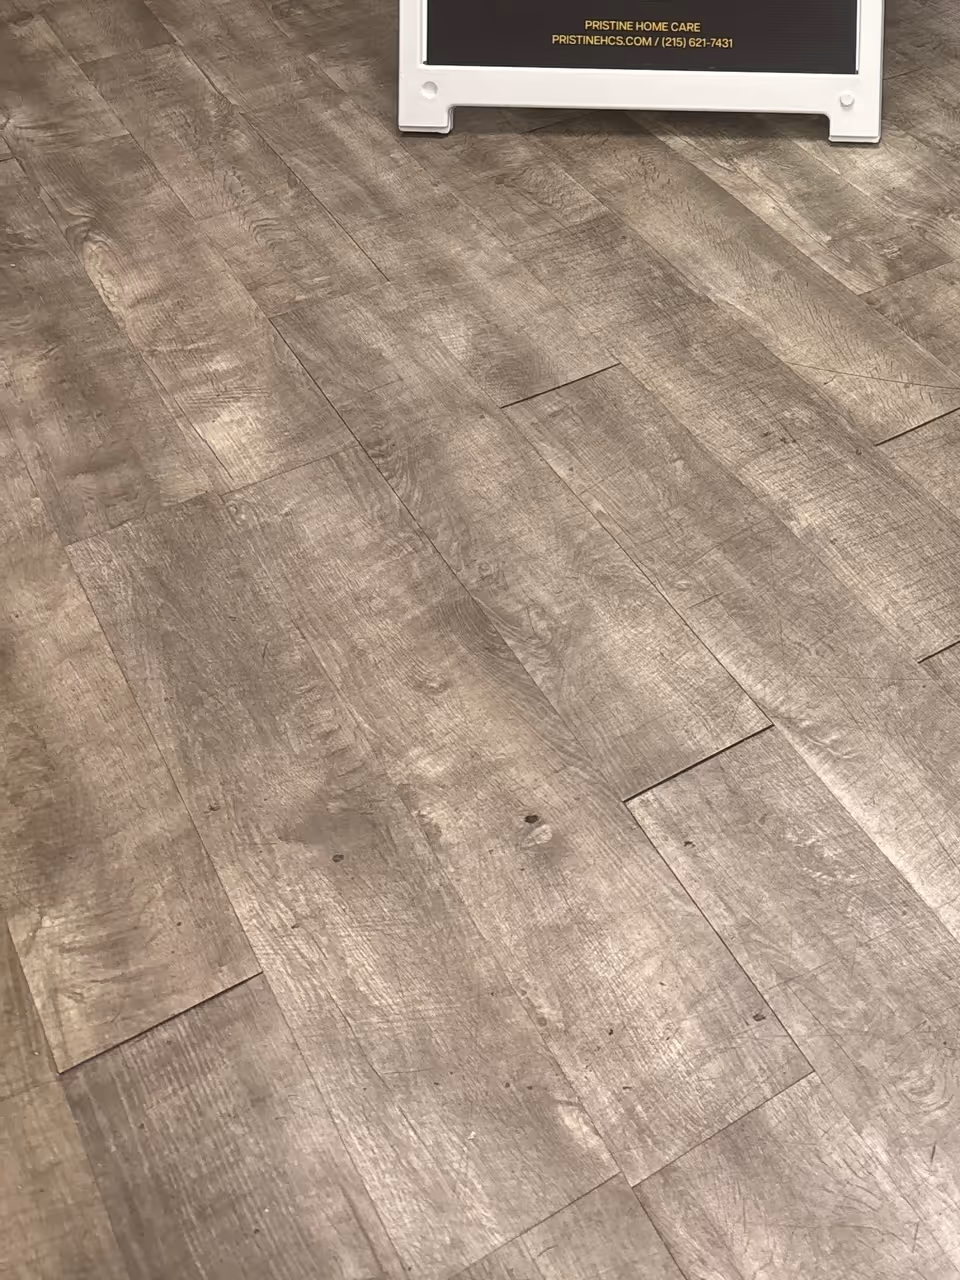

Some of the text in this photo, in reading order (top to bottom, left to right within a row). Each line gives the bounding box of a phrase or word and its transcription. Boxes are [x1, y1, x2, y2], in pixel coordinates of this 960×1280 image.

[584, 20, 701, 33] PRISTINE HOME CARE
[552, 34, 733, 49] PRISTINEHCS.COM / (215) 621-7431
